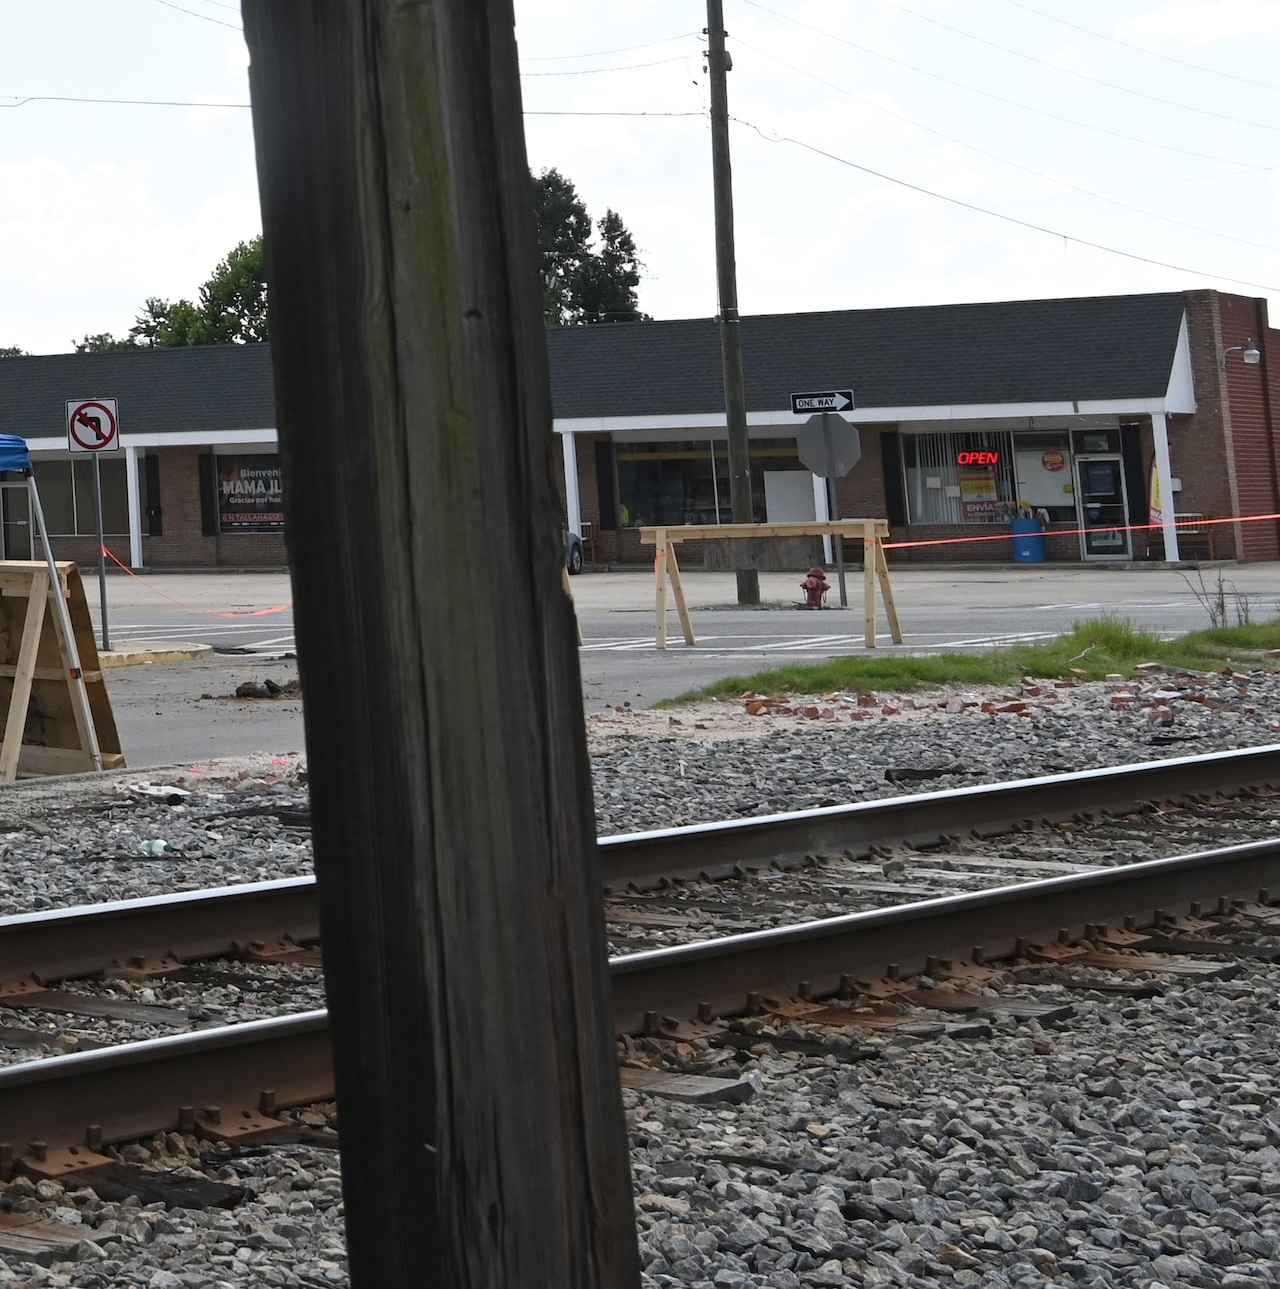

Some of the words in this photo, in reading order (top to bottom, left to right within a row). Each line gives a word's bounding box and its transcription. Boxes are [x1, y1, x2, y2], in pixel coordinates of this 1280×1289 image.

[798, 398, 816, 408] ONE
[817, 397, 834, 407] WAY
[958, 452, 999, 465] OPEN
[222, 480, 266, 495] MAMA
